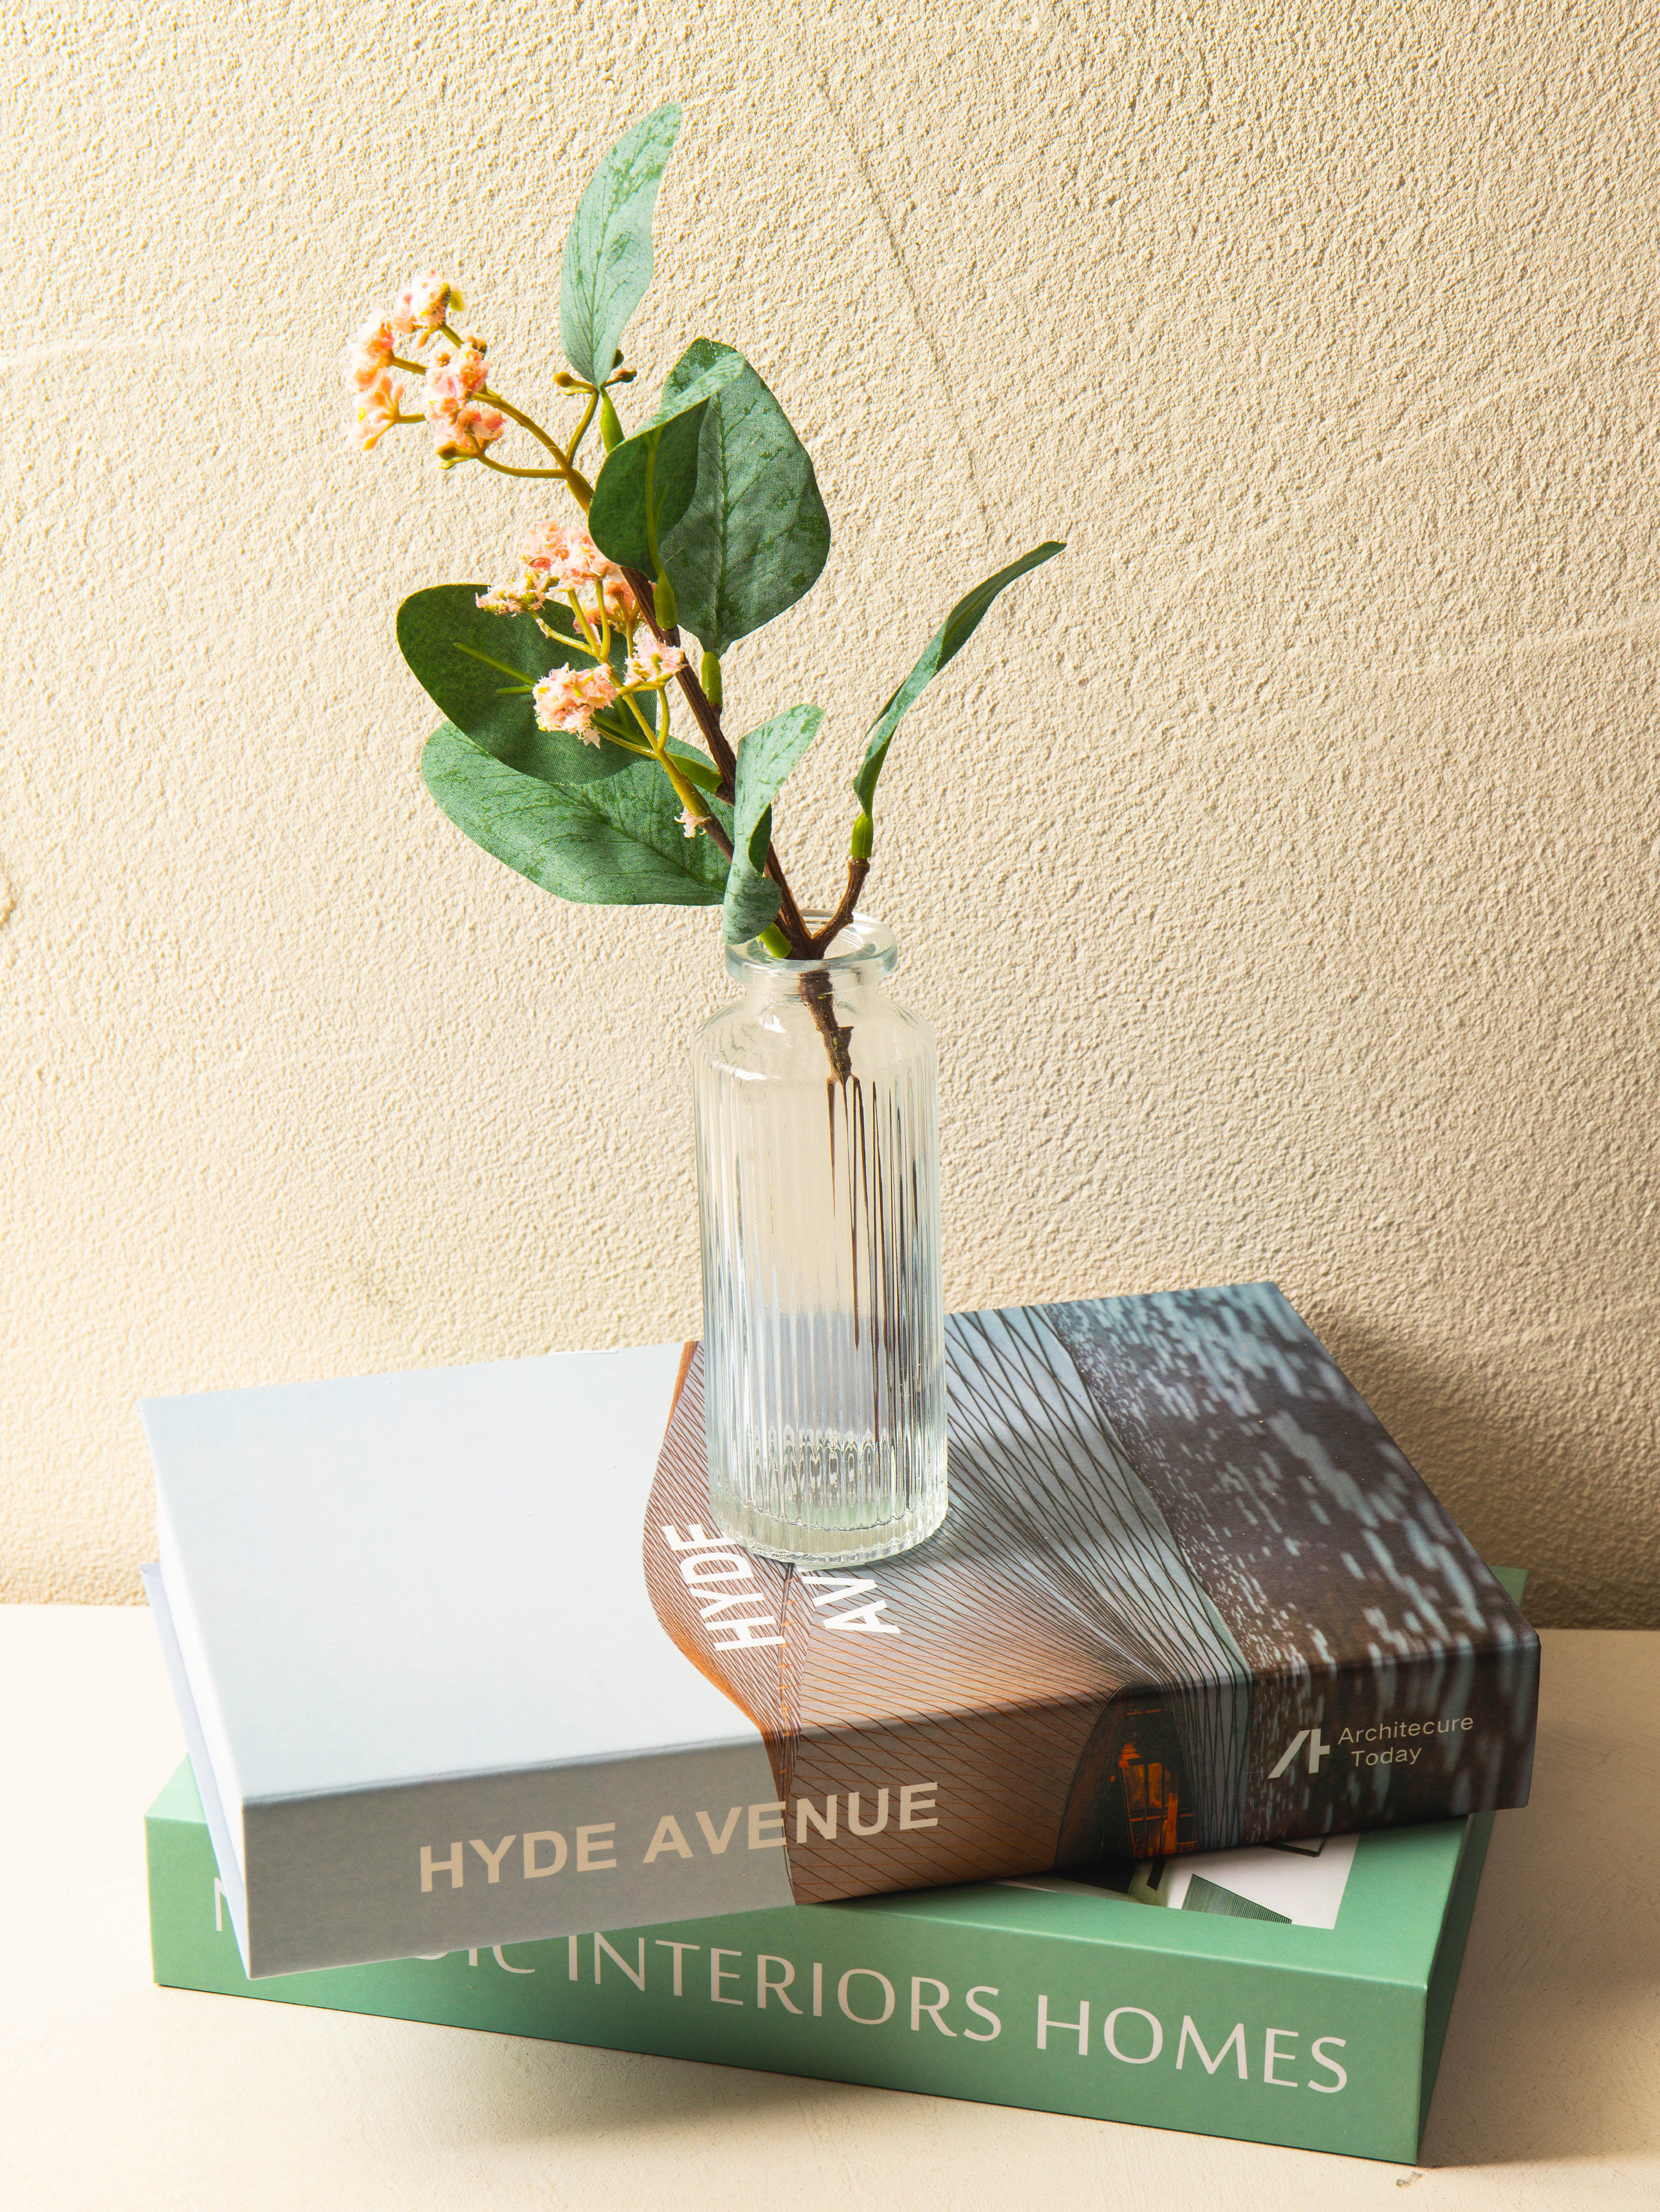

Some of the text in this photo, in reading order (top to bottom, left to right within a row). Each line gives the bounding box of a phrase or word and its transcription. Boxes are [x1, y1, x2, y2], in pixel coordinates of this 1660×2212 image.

[661, 1524, 786, 1651] HYDE
[1338, 1717, 1473, 1745] Architecure
[1351, 1747, 1422, 1767] Today
[420, 1782, 939, 1892] HYDE AVENUE
[568, 1931, 1347, 2093] INTERIORS HOMES
